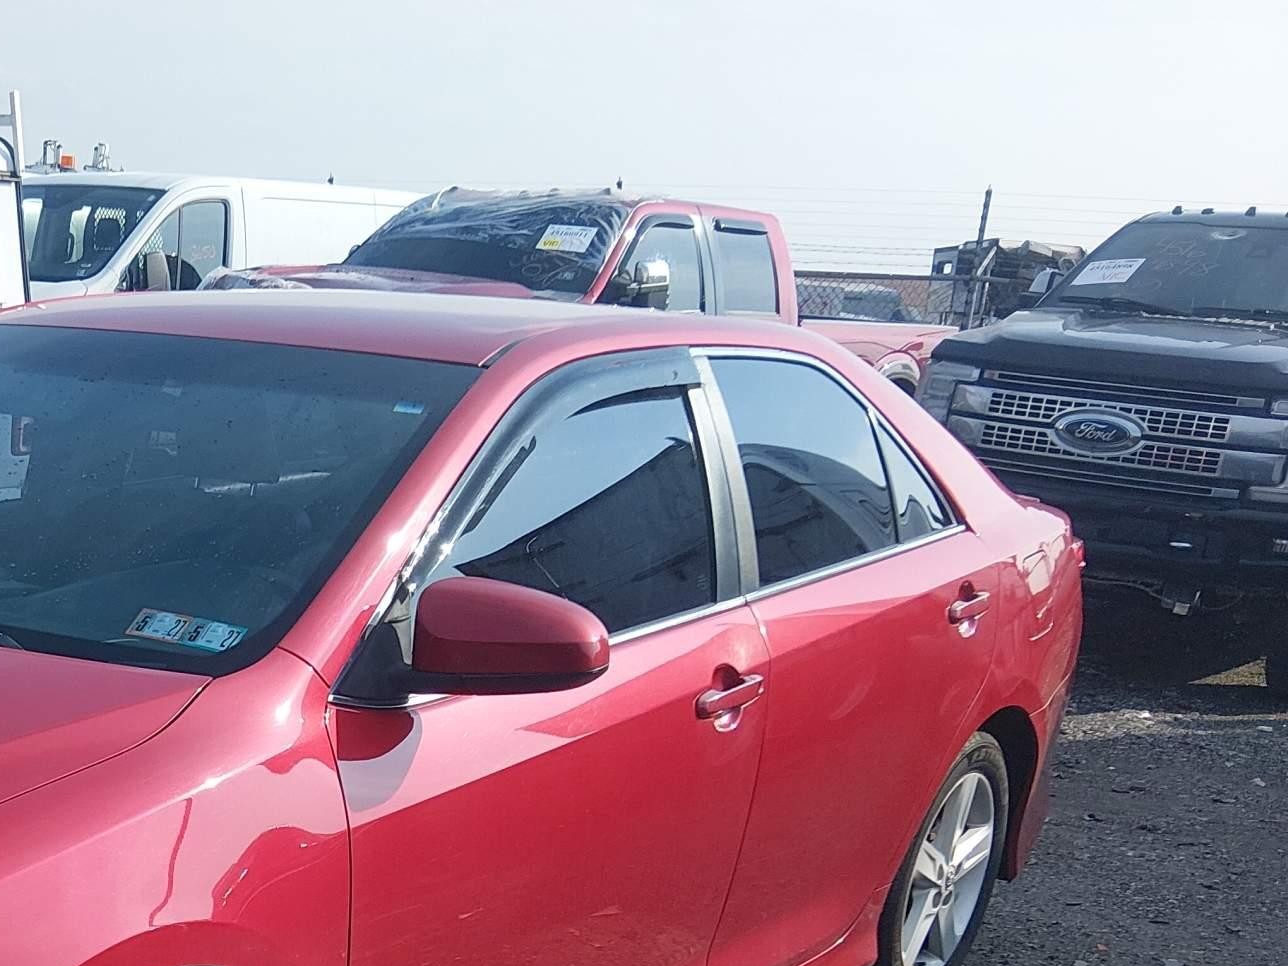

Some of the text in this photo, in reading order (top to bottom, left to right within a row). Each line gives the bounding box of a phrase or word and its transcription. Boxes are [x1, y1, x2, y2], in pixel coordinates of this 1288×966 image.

[1075, 421, 1117, 440] Ford
[168, 619, 187, 637] 27
[220, 630, 241, 649] 27
